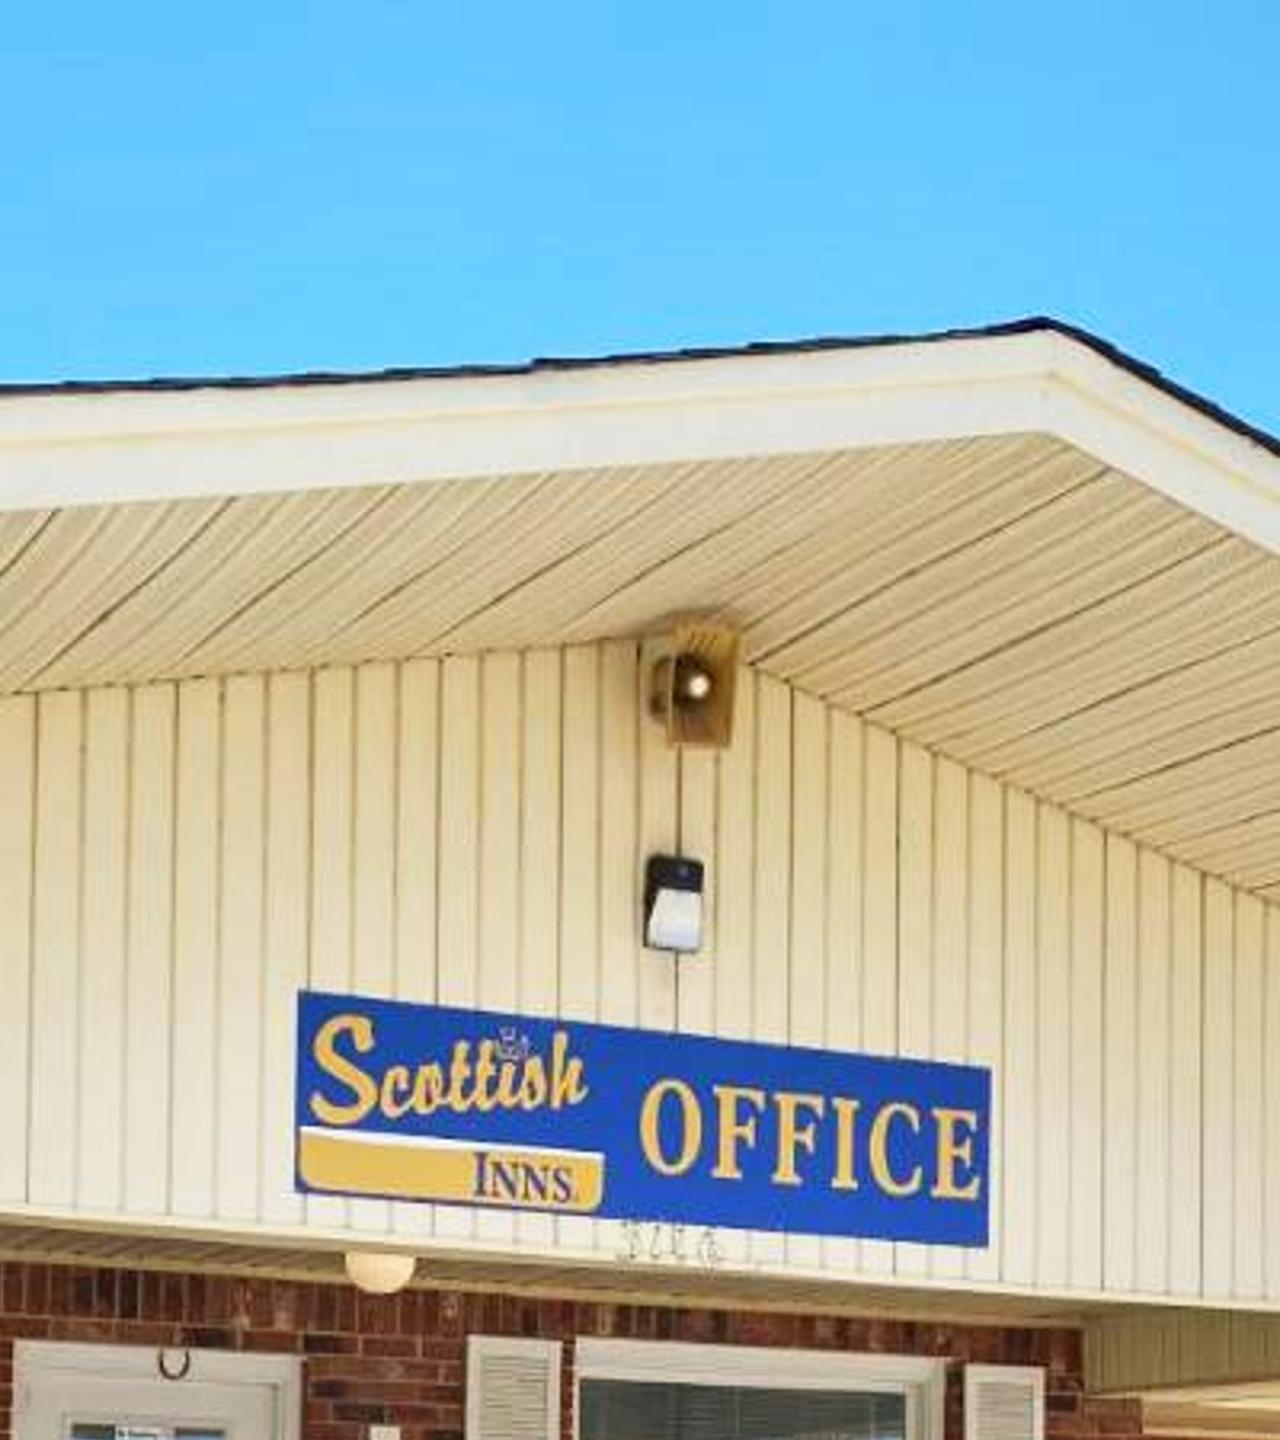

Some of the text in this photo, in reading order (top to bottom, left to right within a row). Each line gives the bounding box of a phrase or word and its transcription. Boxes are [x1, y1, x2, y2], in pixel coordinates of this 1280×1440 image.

[309, 1013, 589, 1125] Scottish
[472, 1151, 573, 1203] INNS
[639, 1079, 981, 1202] OFFICE
